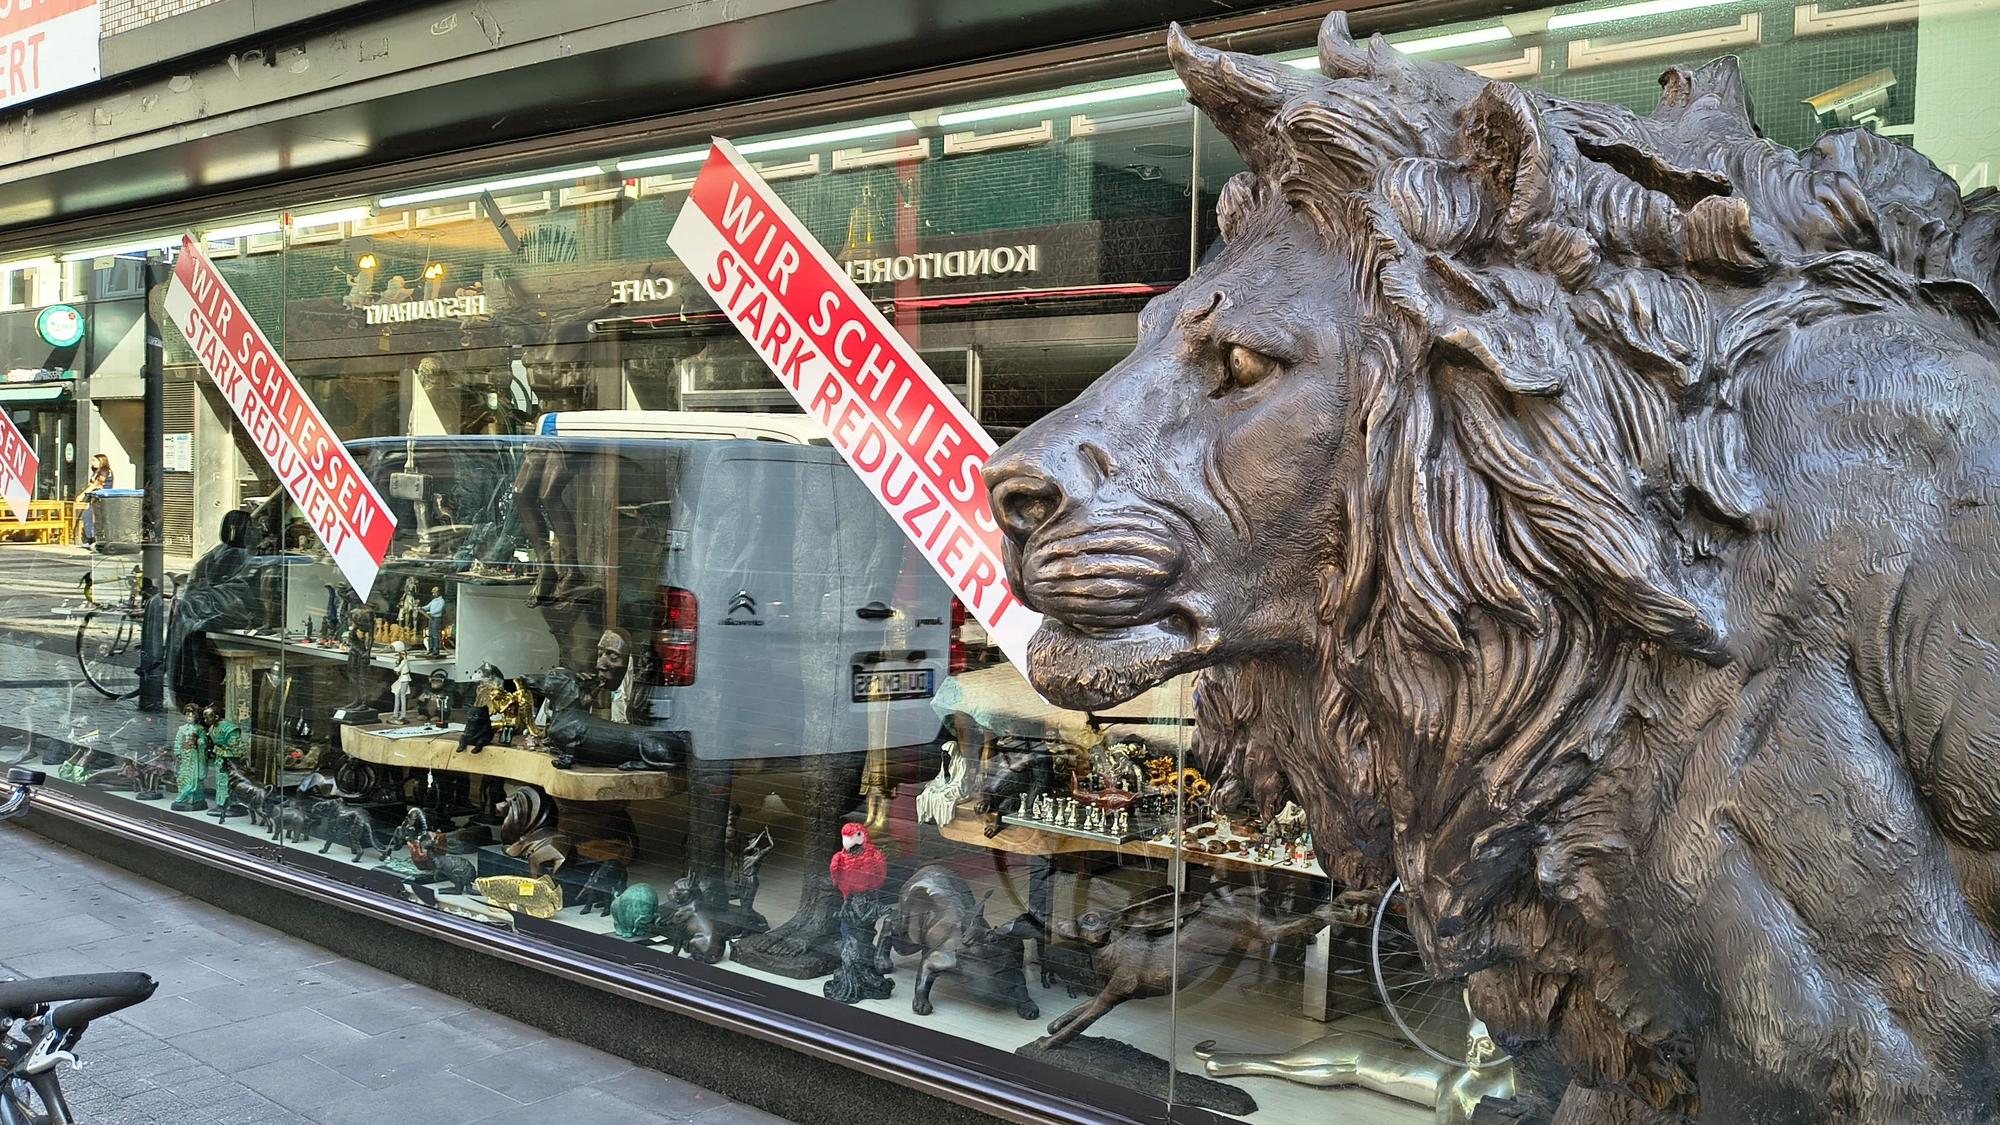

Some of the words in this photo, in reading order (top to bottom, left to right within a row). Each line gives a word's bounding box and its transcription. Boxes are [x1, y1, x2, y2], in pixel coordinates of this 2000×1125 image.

[721, 181, 800, 296] WIR
[186, 308, 242, 404] STARK
[241, 390, 350, 555] REDUZIERT
[191, 258, 232, 338] WIR
[238, 332, 375, 537] SCHLIESSEN
[707, 250, 816, 391] STARK
[811, 372, 1023, 628] REDUZIERT
